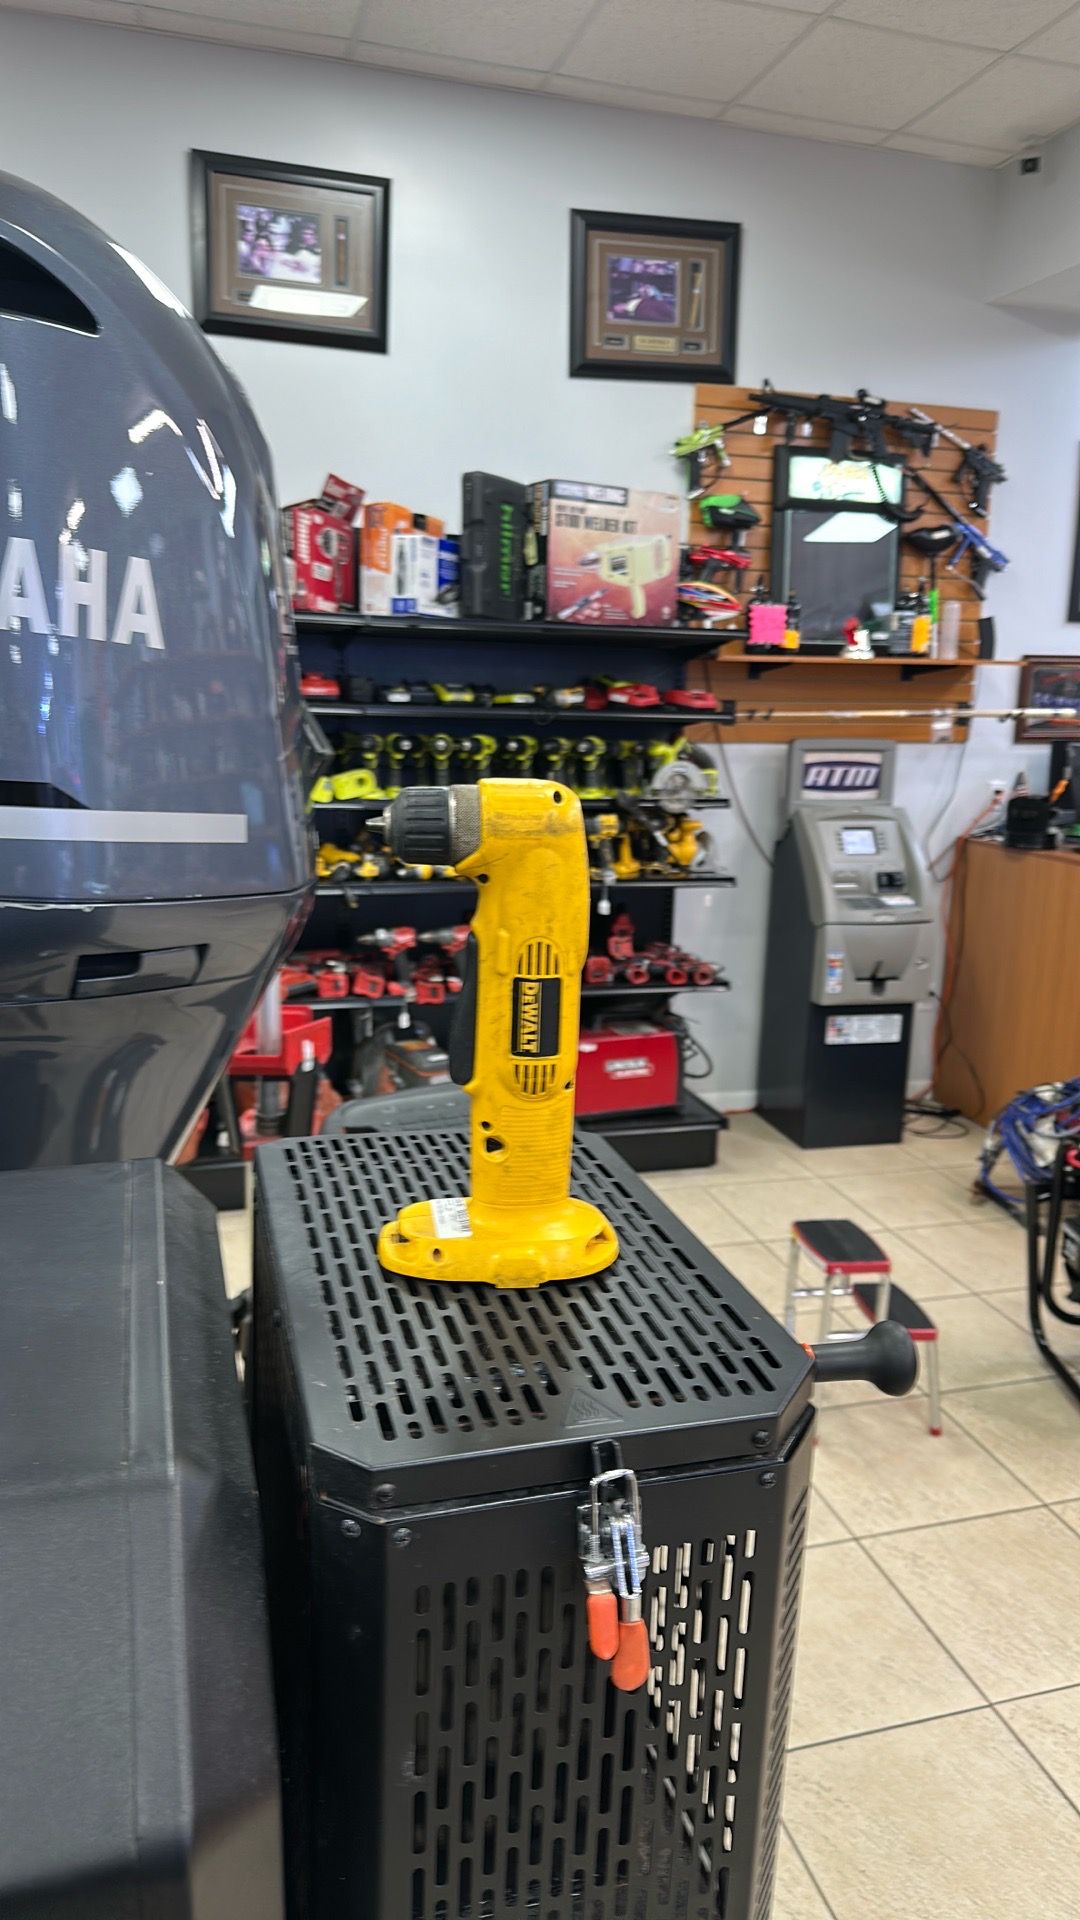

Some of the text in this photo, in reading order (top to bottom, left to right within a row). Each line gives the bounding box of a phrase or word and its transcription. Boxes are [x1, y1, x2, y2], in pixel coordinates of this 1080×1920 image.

[585, 516, 619, 533] WELDER
[804, 765, 880, 787] ATM
[520, 982, 540, 1053] DEWALT
